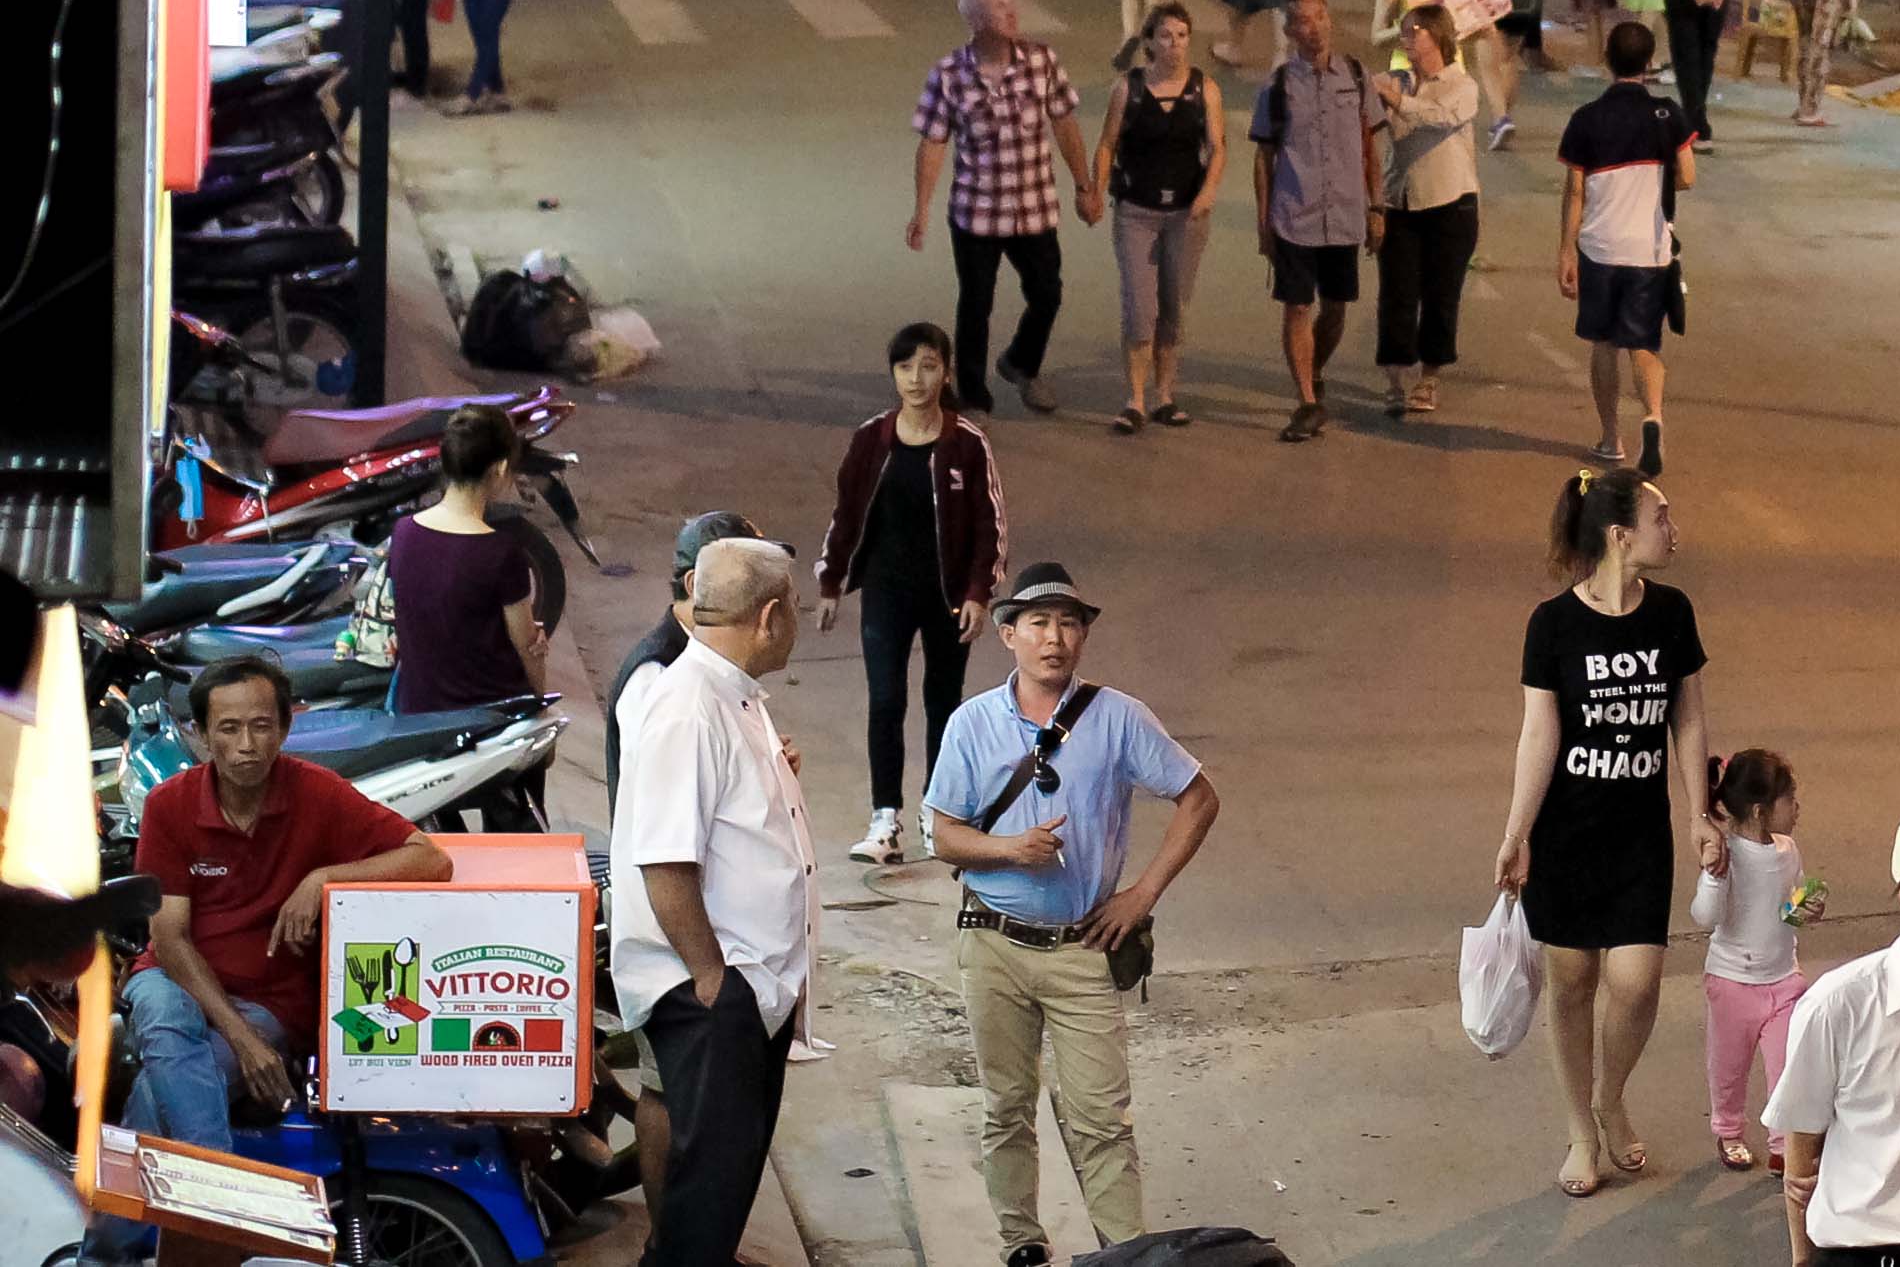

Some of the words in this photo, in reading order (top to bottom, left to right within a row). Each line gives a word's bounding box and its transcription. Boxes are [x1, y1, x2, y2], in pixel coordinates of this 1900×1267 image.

[1585, 649, 1660, 681] BOY
[1589, 686, 1626, 698] STEEL
[1629, 685, 1642, 694] IN
[1645, 683, 1667, 693] THE
[1581, 699, 1668, 728] HOUR
[1616, 735, 1631, 744] OF
[1566, 746, 1663, 780] CHAOS
[435, 948, 482, 971] ITALIAN
[485, 947, 562, 971] RESTAURANT
[424, 971, 570, 1000] VITTORIO
[453, 1004, 476, 1012] PIZZA
[483, 1004, 508, 1012] PASTA
[420, 1055, 458, 1067] WOOD
[463, 1055, 497, 1067] FIRED
[502, 1055, 534, 1067] OVEN
[538, 1055, 573, 1068] PIZZA
